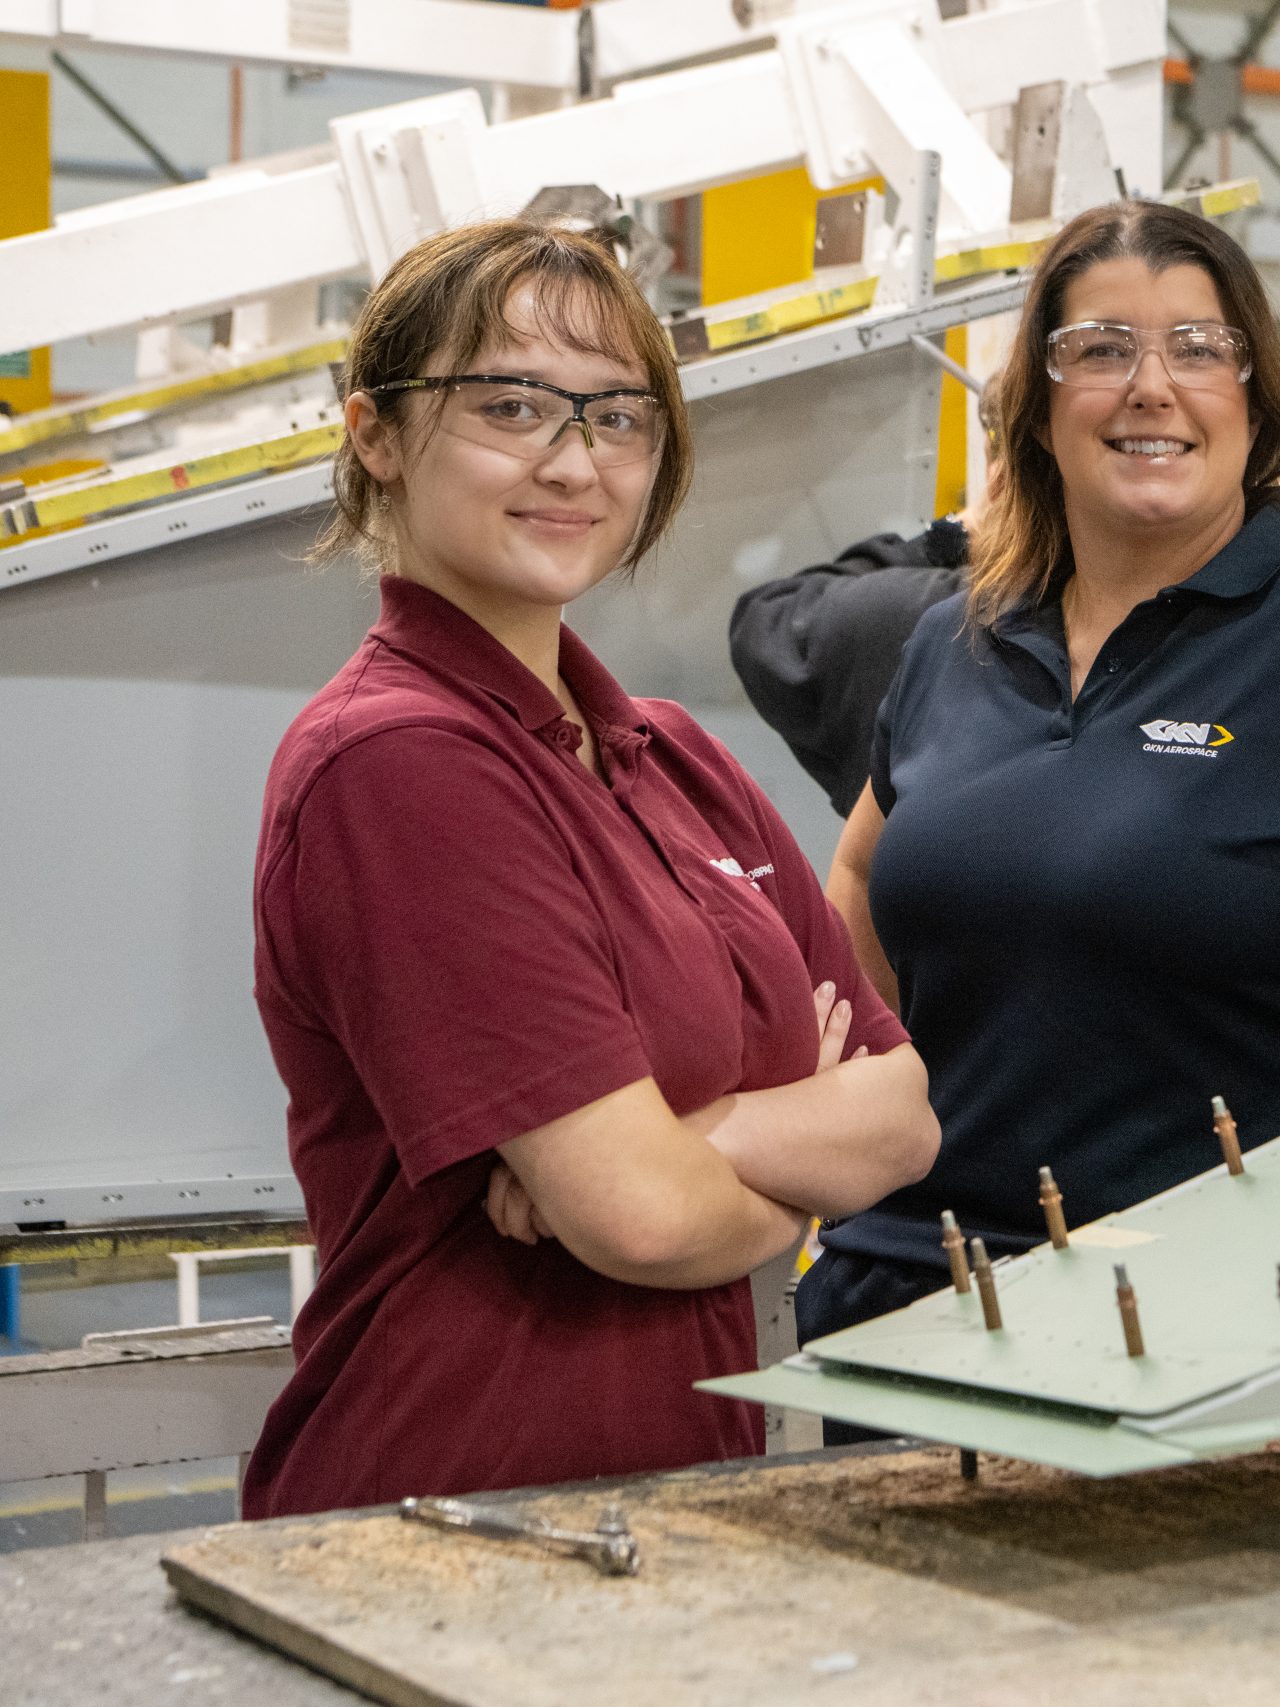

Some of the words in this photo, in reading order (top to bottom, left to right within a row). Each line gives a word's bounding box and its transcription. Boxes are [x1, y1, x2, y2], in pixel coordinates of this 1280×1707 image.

[408, 379, 426, 387] uvex
[1142, 743, 1164, 754] GKN
[1164, 745, 1218, 758] AEROSPACE
